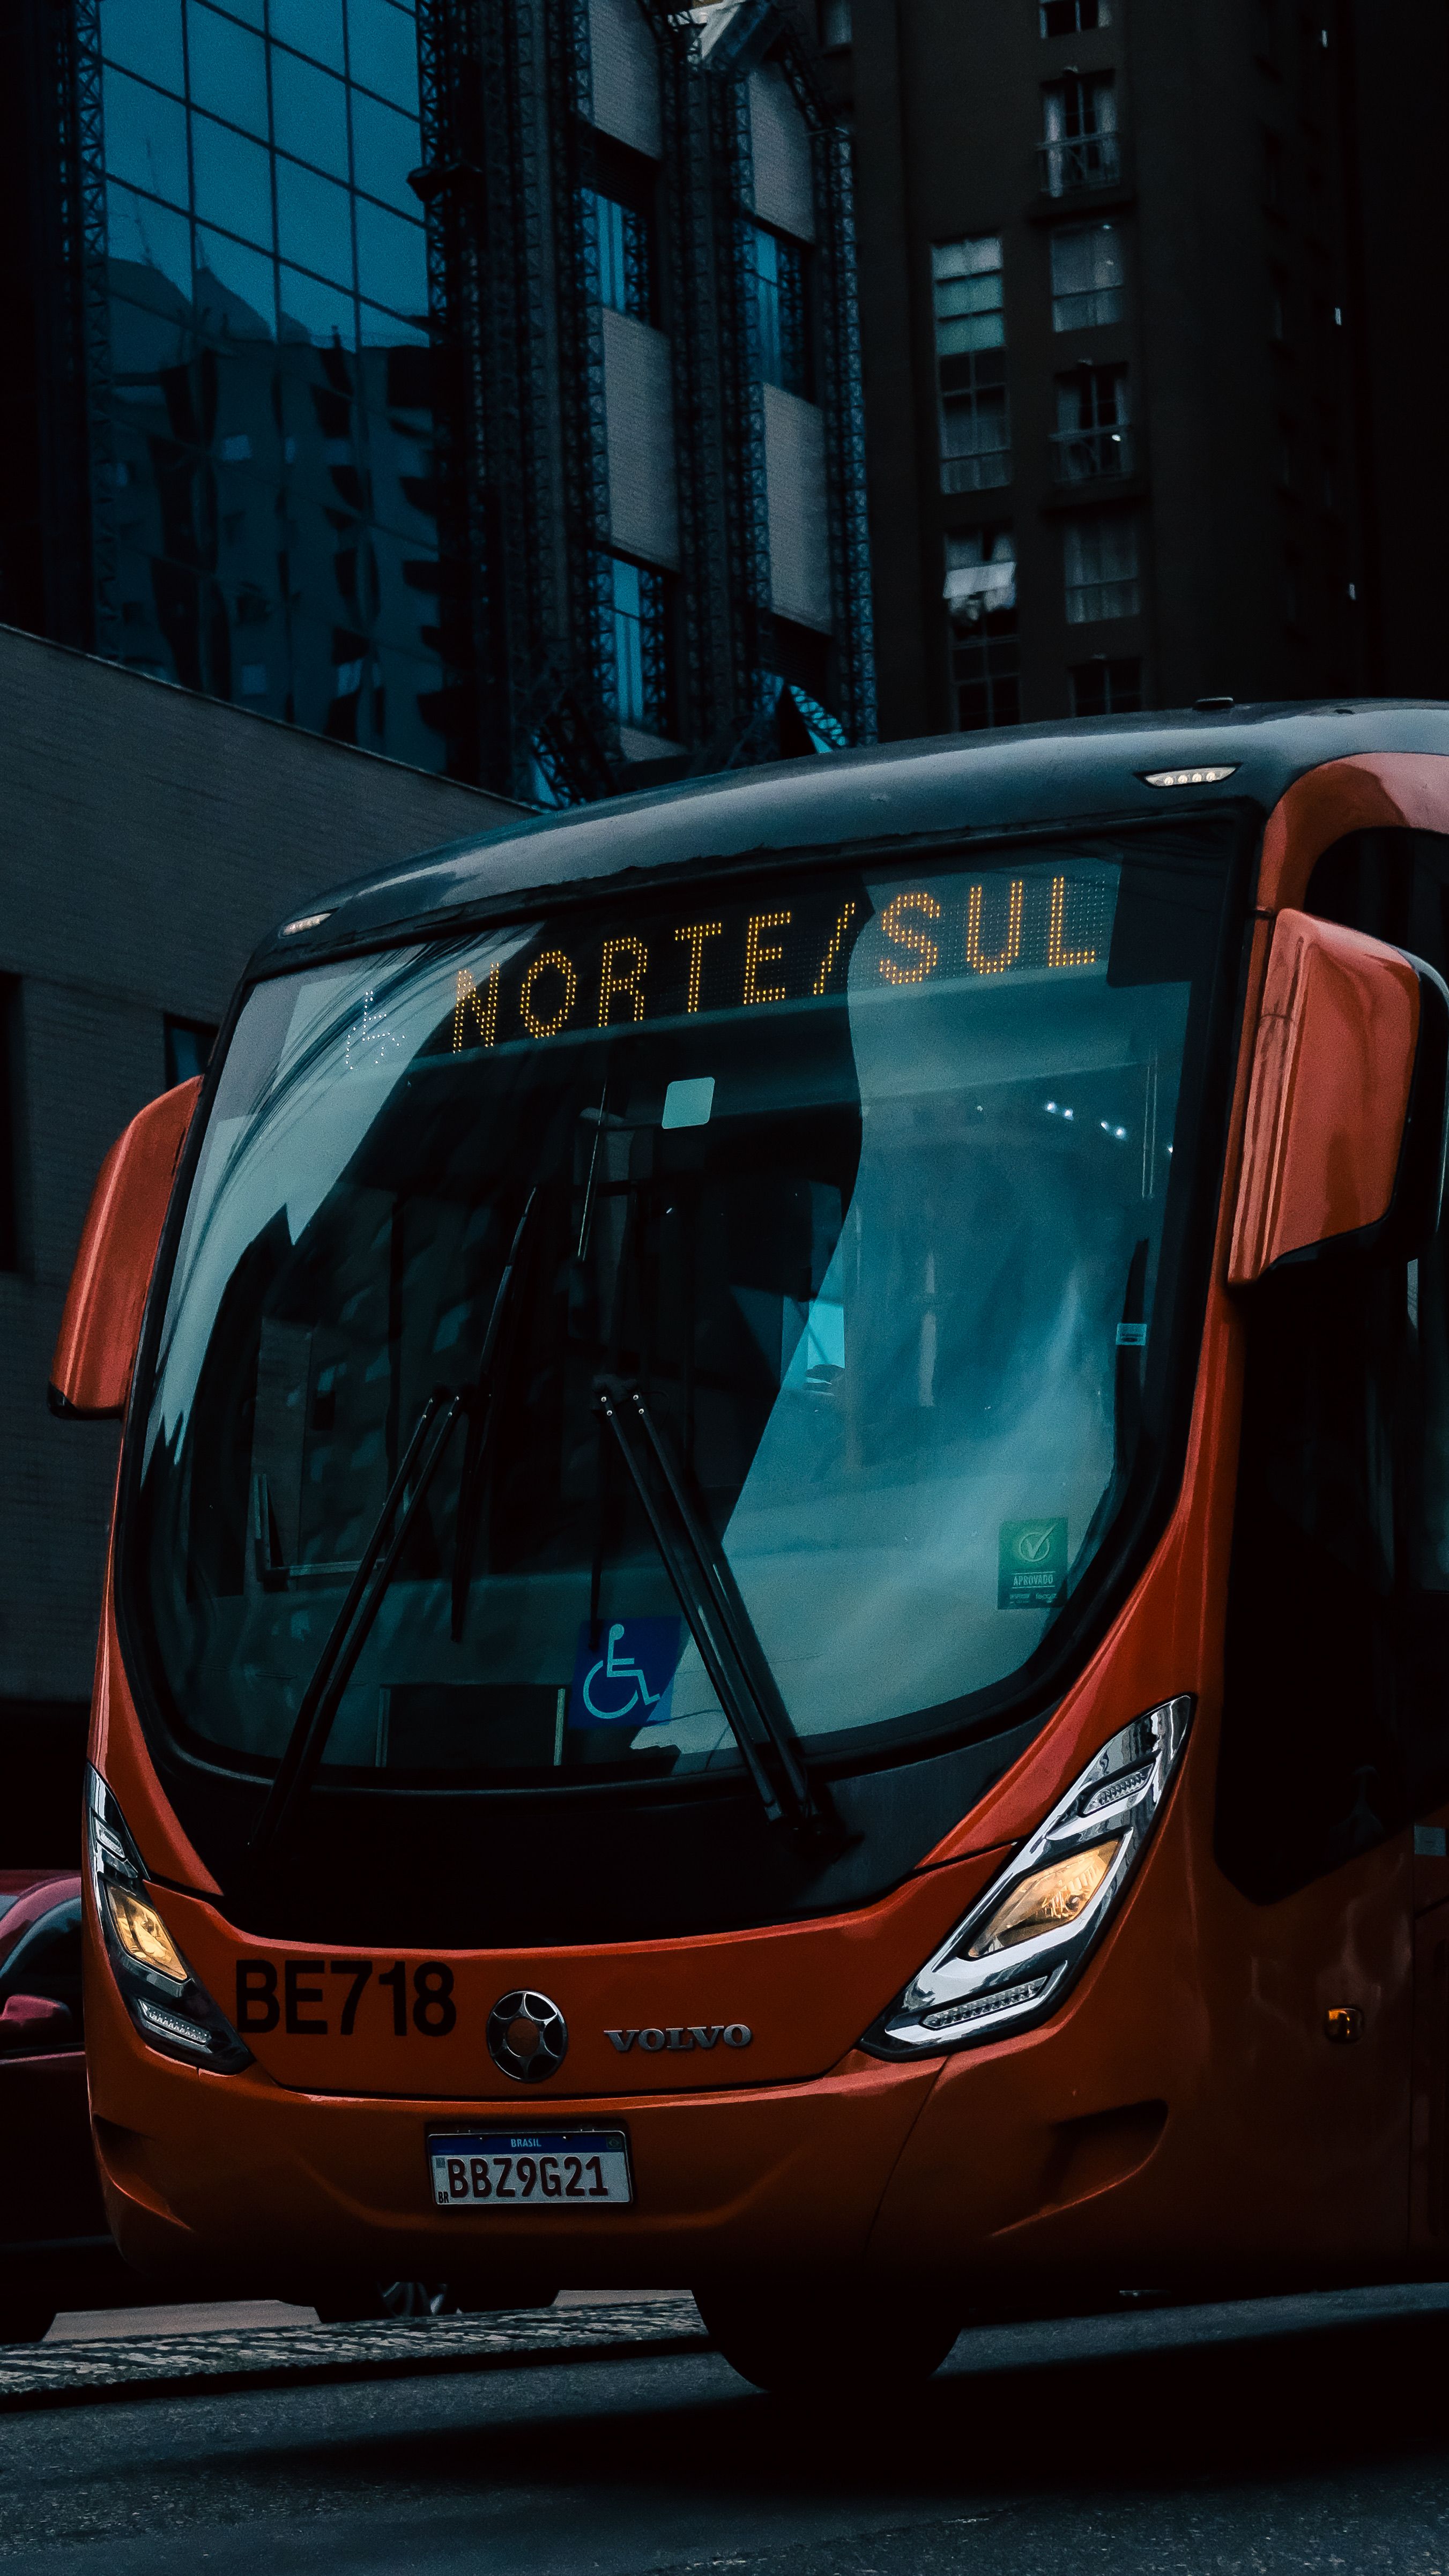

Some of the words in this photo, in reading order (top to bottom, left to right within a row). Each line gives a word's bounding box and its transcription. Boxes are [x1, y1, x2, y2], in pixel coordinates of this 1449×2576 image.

[452, 876, 1096, 1054] NORTE/SUL
[1013, 1574, 1053, 1585] APROVADO
[236, 1960, 457, 2036] BE718
[604, 2024, 752, 2051] VOLVO
[510, 2139, 541, 2148] BRASIL
[447, 2156, 608, 2198] BBZ9G21
[438, 2192, 449, 2203] BR
